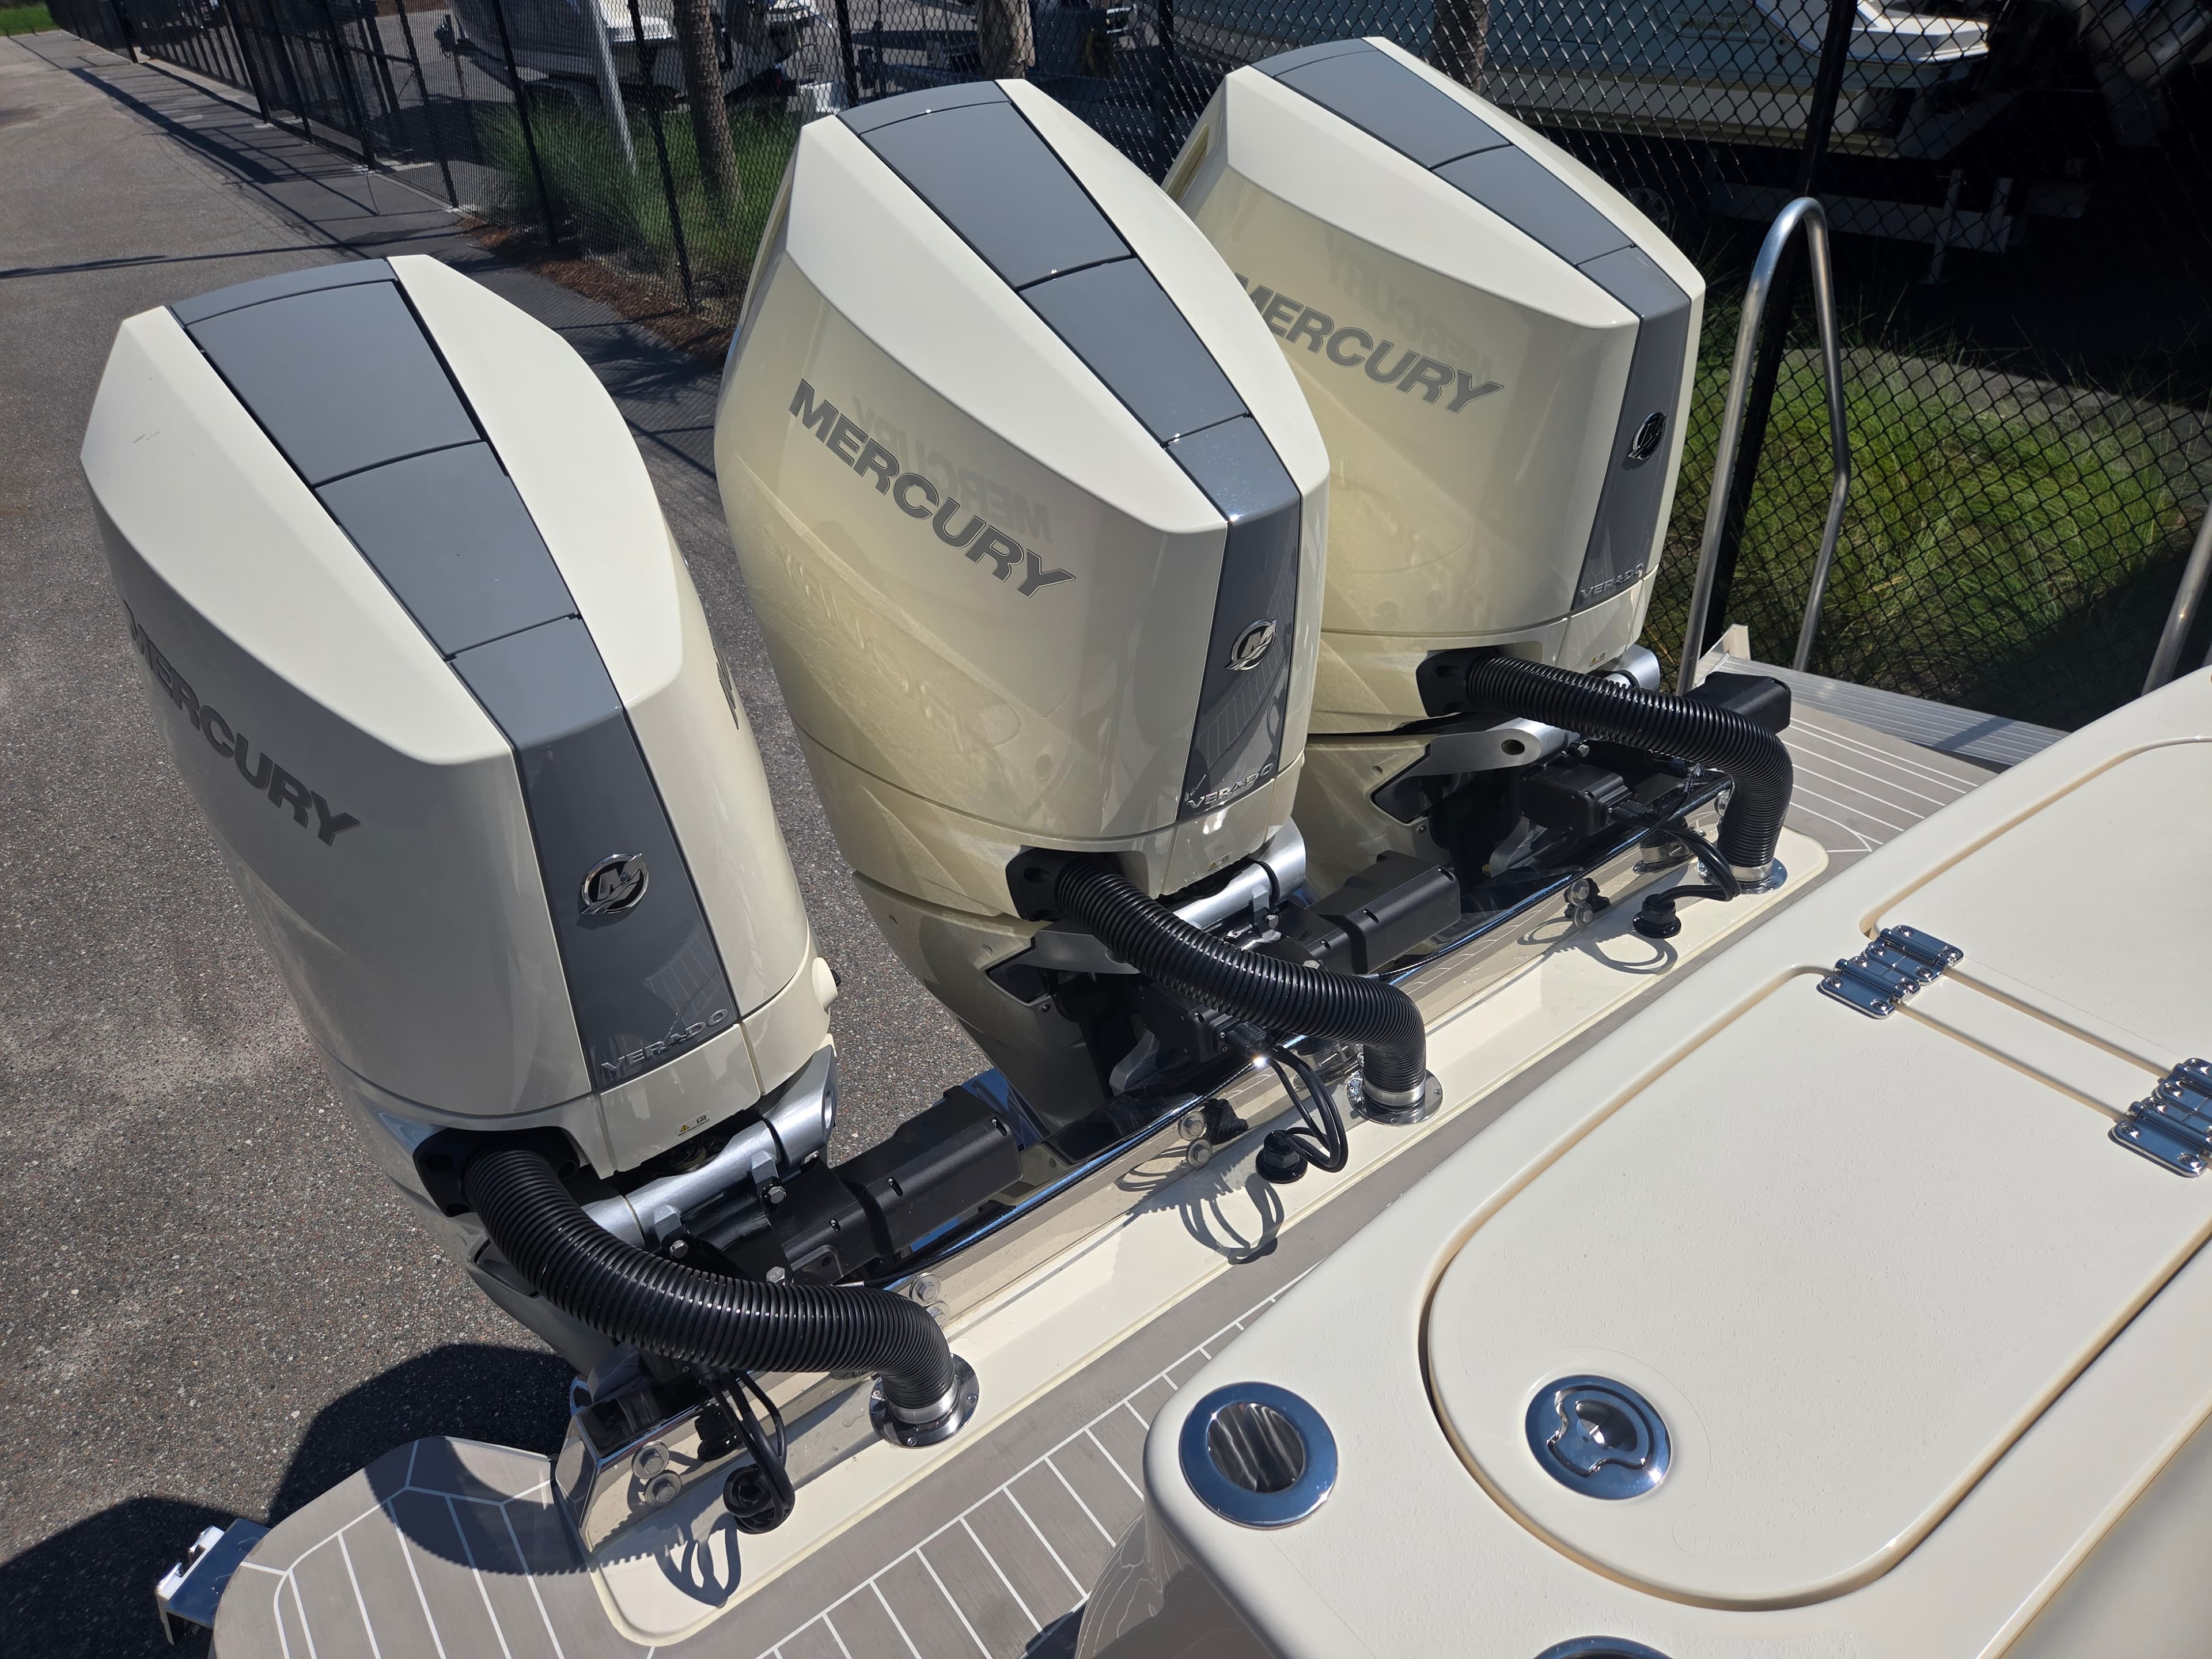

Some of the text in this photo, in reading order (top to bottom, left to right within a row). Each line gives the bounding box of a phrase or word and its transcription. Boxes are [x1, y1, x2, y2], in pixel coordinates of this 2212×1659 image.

[789, 378, 1076, 599] MERCURY
[1188, 763, 1274, 809] VERADO
[601, 1009, 728, 1071] VERADO
